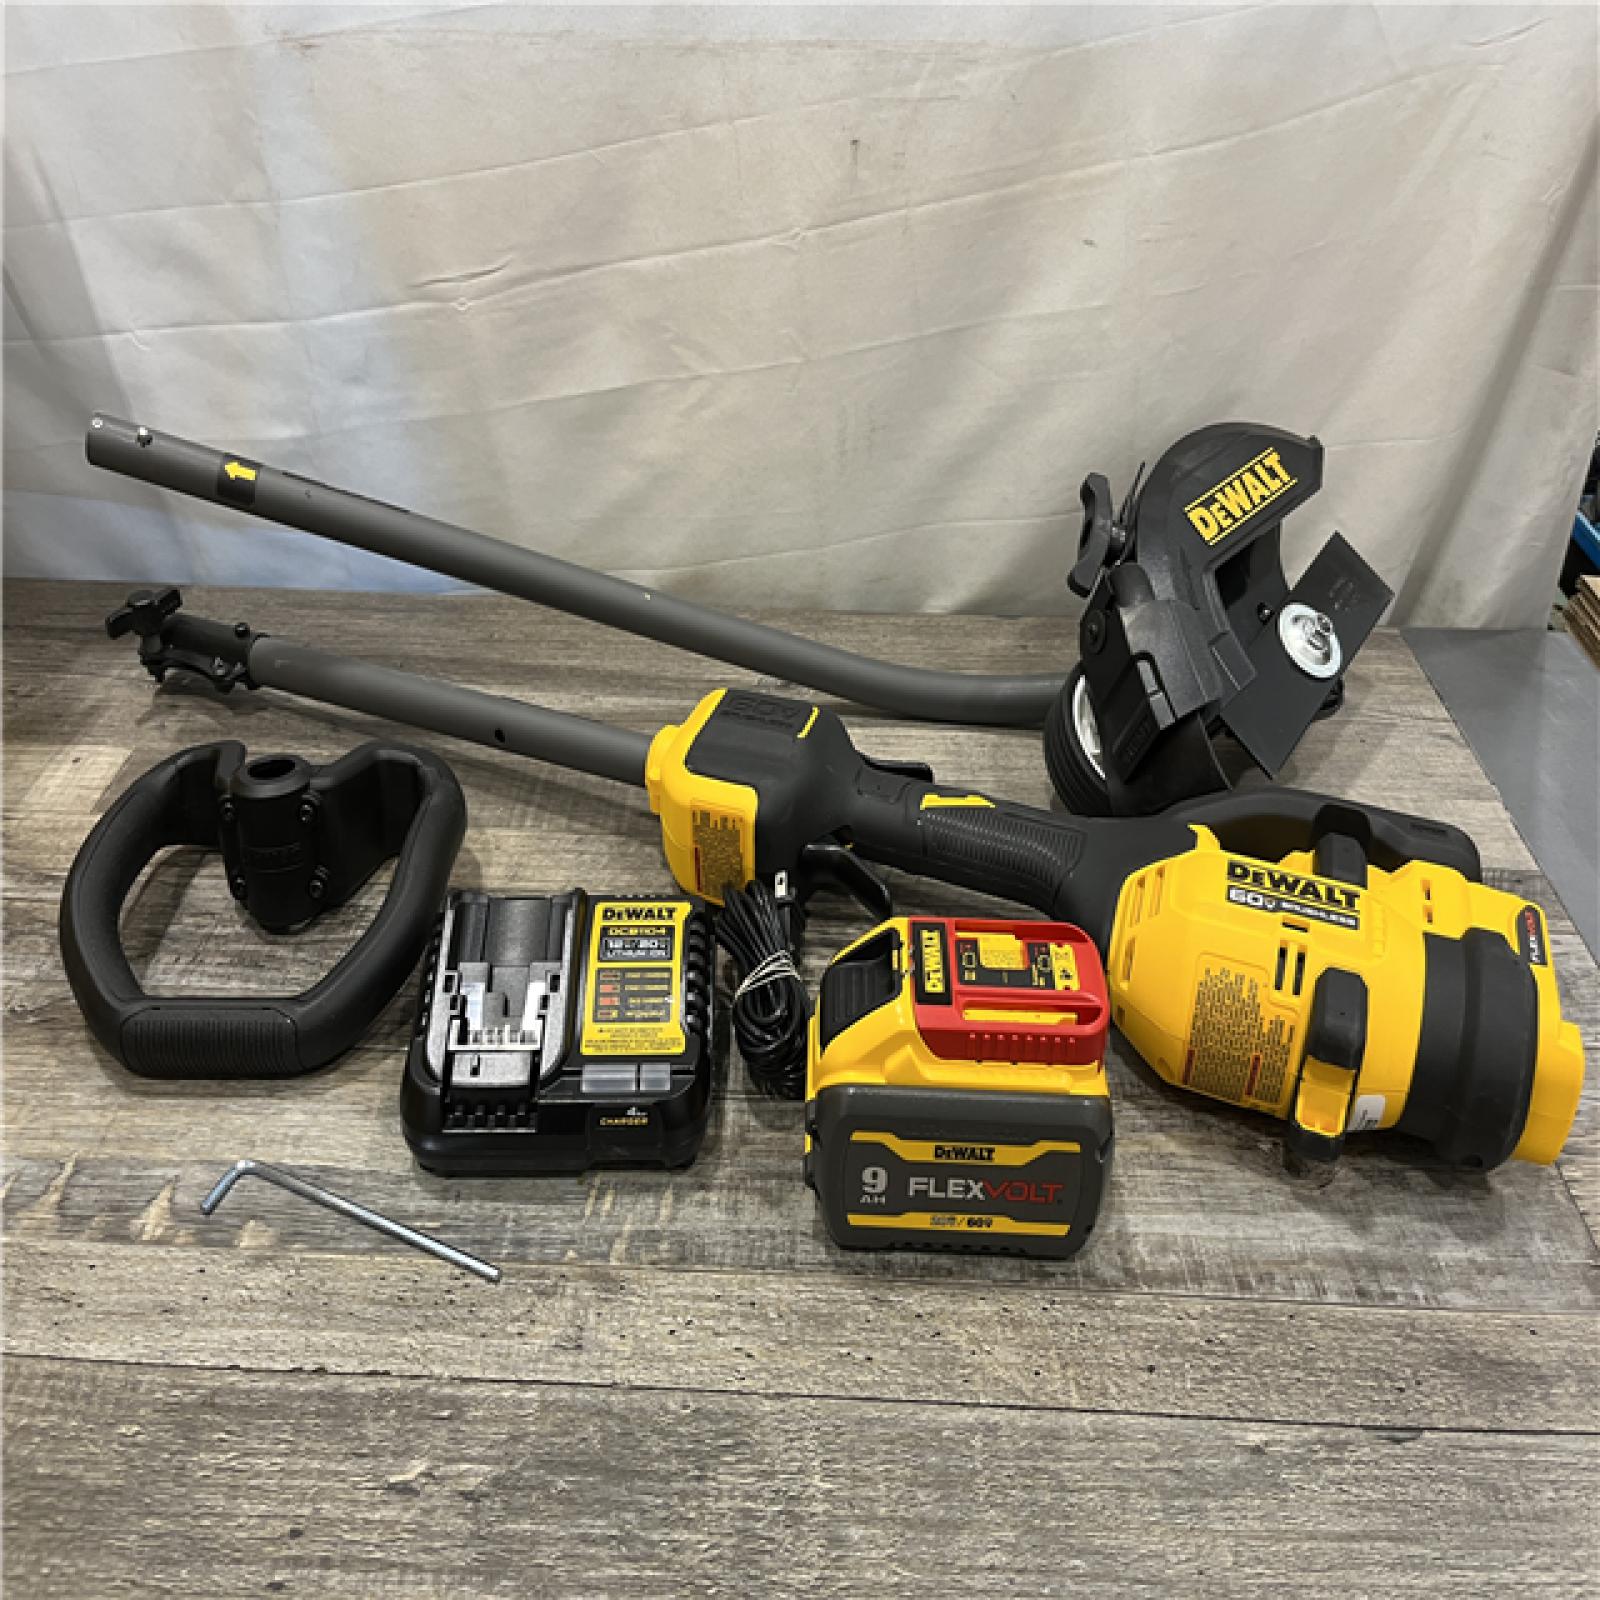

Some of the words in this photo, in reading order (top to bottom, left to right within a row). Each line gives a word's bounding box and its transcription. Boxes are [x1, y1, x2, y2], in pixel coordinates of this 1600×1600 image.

[1187, 451, 1293, 543] DEWALT
[1227, 860, 1361, 908] DEWALT
[602, 907, 676, 920] DEWALT
[933, 1145, 996, 1161] DEWALT
[861, 1166, 888, 1193] 9
[907, 1176, 1064, 1204] FLEXVOLT
